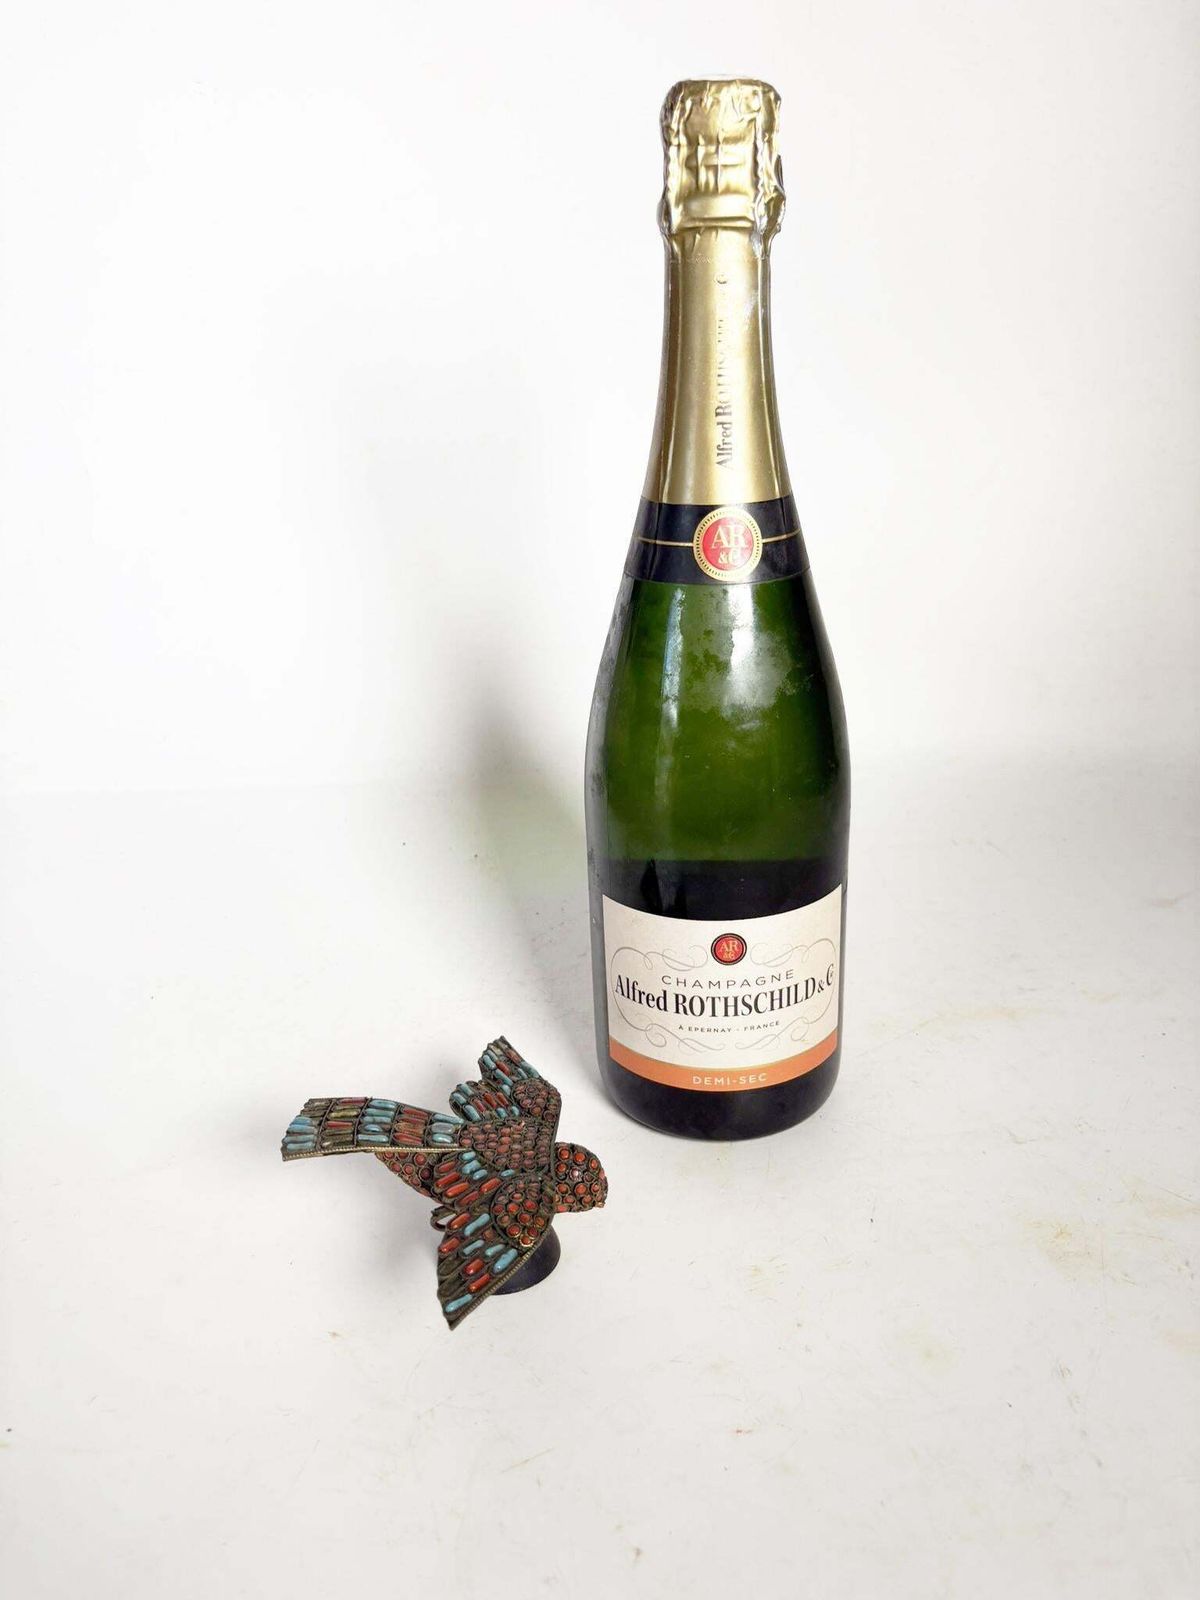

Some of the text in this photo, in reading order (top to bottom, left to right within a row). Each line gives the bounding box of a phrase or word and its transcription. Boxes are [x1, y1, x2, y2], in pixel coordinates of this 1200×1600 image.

[715, 422, 733, 469] Alfred
[711, 525, 748, 549] AR
[719, 940, 738, 952] AR
[661, 968, 794, 990] CHAMPAGNE
[615, 974, 669, 1012] Alfred
[673, 977, 816, 1018] ROTHSCHILD
[743, 1020, 780, 1032] FRANCE
[692, 1072, 768, 1086] DEMI-SEC
